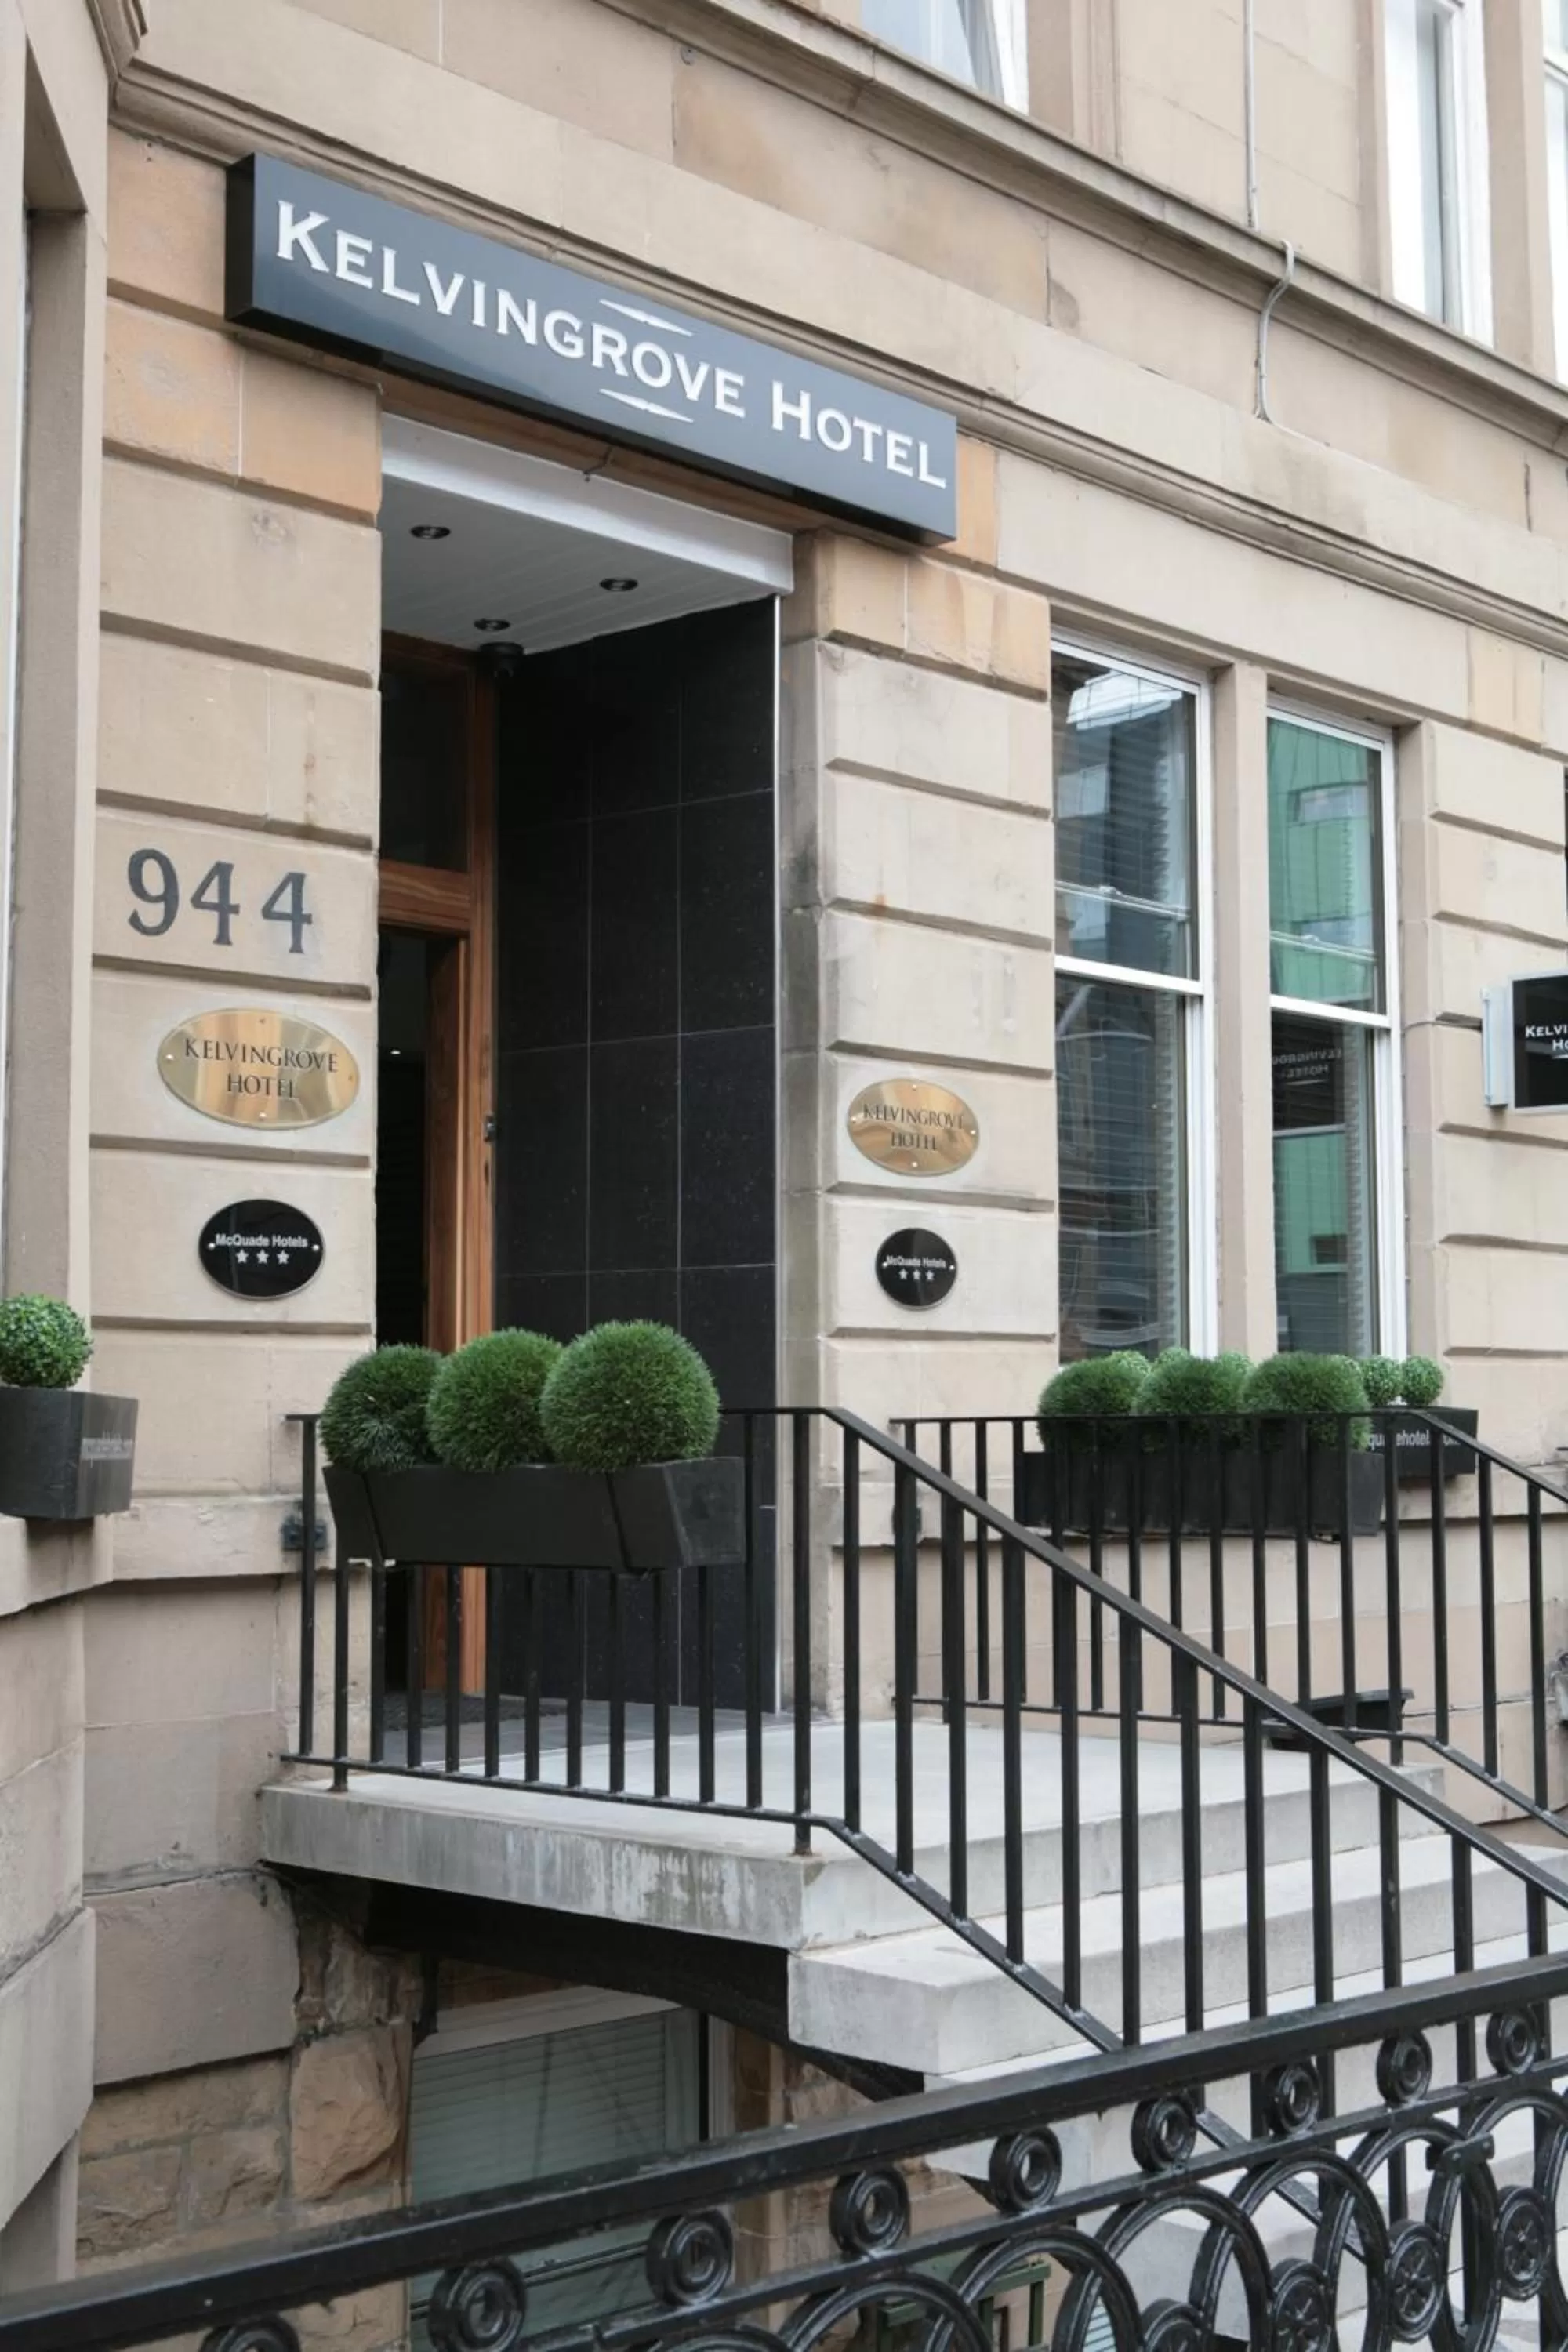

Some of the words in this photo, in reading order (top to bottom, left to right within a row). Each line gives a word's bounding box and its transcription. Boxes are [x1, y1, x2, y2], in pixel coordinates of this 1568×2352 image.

[277, 200, 746, 418] KELVINGROVE
[771, 381, 946, 489] HOTEL
[127, 848, 313, 954] 944
[184, 1038, 338, 1073] KELVINGROVE
[227, 1074, 297, 1098] HOTEL
[864, 1104, 964, 1130] KELVINGROVE
[891, 1132, 938, 1151] HOTEL
[215, 1233, 269, 1249] McQuade
[272, 1235, 308, 1249] Hotels
